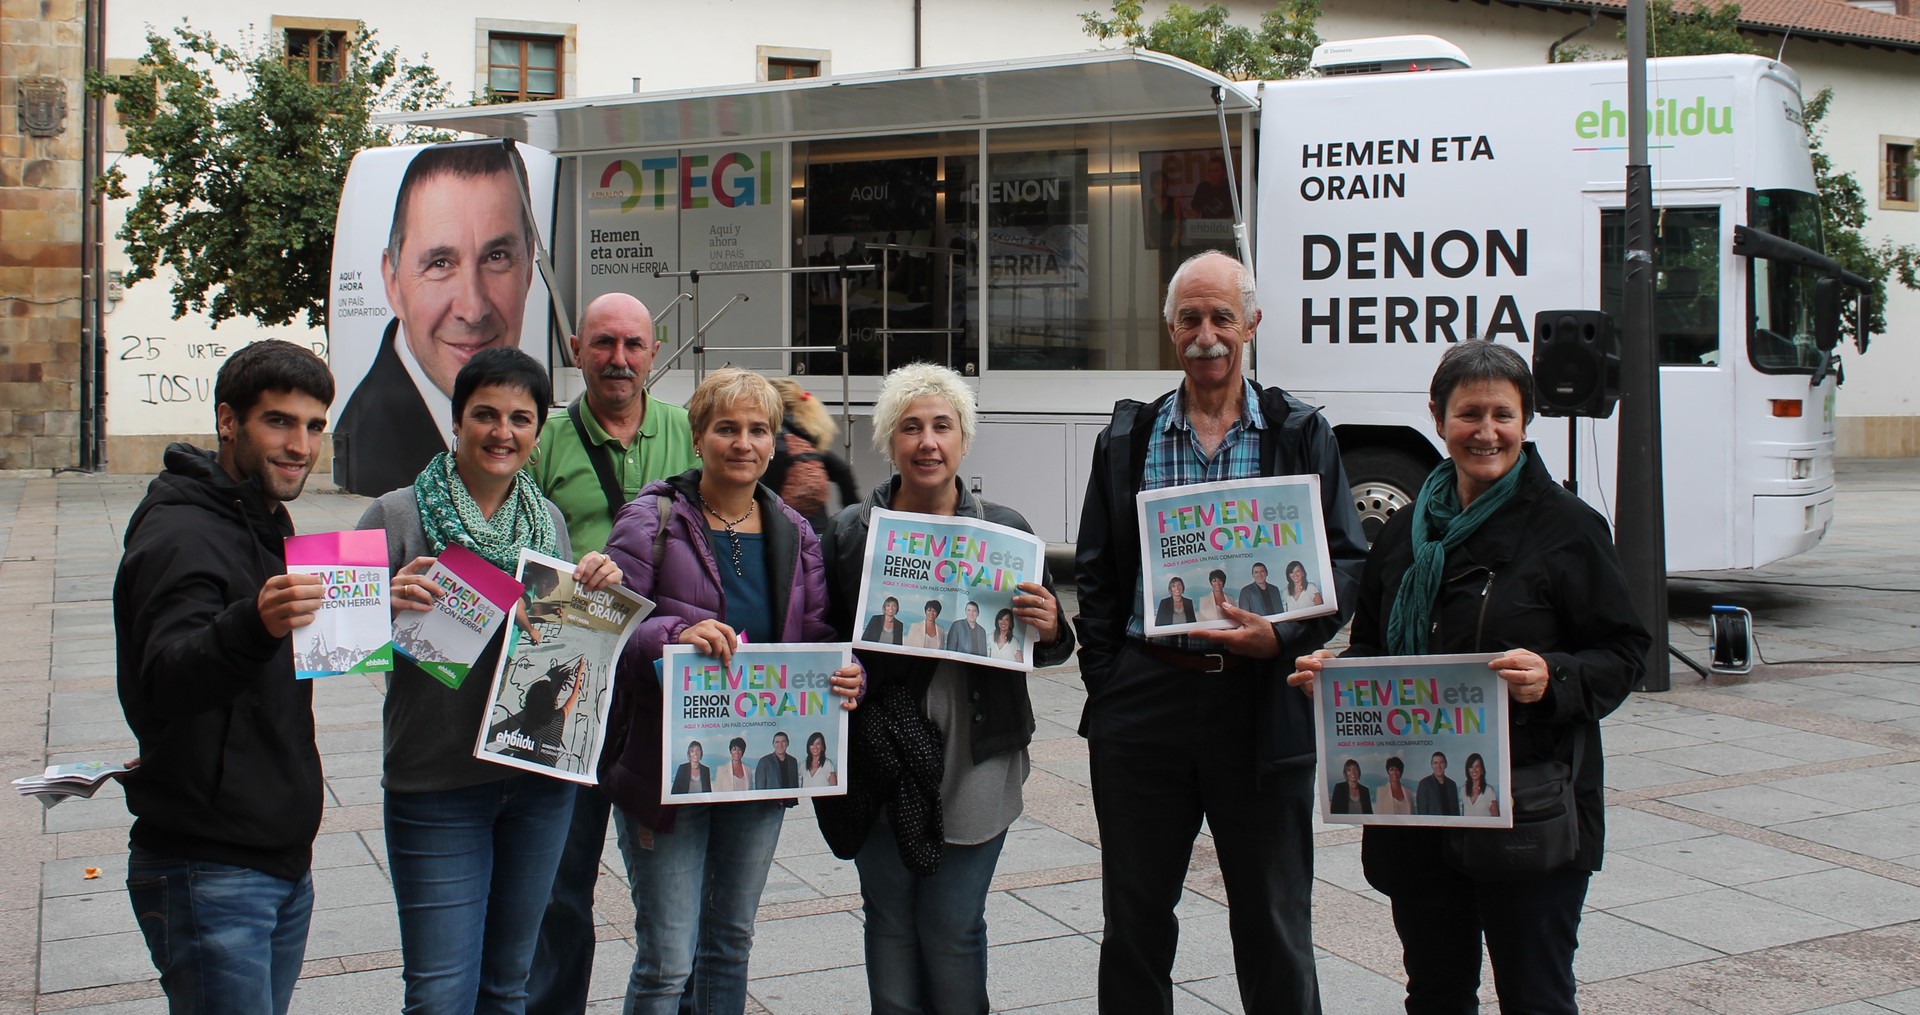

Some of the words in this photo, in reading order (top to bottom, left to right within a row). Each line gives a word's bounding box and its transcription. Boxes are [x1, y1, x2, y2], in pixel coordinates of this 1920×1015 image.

[1575, 96, 1733, 139] ehildu
[1302, 137, 1419, 168] HEMEN
[1431, 135, 1494, 163] ETA
[600, 151, 771, 214] OTEGI
[850, 182, 890, 201] AQUÍ
[1300, 173, 1406, 202] ORAIN
[590, 229, 640, 243] Hemen
[709, 223, 733, 237] Aquí
[735, 226, 741, 237] y
[1191, 223, 1229, 234] ehbildu
[590, 246, 612, 259] eta
[616, 243, 653, 258] orain
[709, 236, 737, 247] ahora
[710, 250, 723, 260] UN
[725, 248, 744, 259] PAÍS
[1302, 229, 1528, 281] DENON
[591, 263, 629, 275] DENON
[632, 261, 669, 273] HERRIA
[709, 260, 771, 271] COMPARTIDO
[357, 271, 362, 280] Y
[339, 282, 363, 291] AHORA
[338, 299, 347, 307] UN
[348, 296, 364, 306] PAÍS
[338, 307, 387, 317] COMPARTIDO
[1302, 295, 1530, 344] HERRIA
[120, 335, 166, 361] 25
[187, 342, 228, 359] URTE
[138, 373, 210, 405] IOSU
[1157, 498, 1260, 534] HEMEN
[1263, 502, 1299, 521] eta
[1160, 531, 1206, 548] DENON
[1209, 522, 1303, 551] ORAIN
[887, 530, 987, 563] HEMEN
[989, 550, 1024, 571] eta
[1161, 543, 1207, 559] HERRIA
[309, 570, 357, 585] MEN
[359, 571, 380, 582] eta
[883, 566, 930, 581] HERRIA
[884, 555, 931, 570] DENON
[934, 560, 1024, 594] ORAIN
[328, 583, 381, 599] ORAIN
[432, 571, 480, 607] HEMEN
[477, 603, 495, 618] eta
[347, 598, 381, 607] HERRIA
[448, 596, 491, 628] ORAIN
[612, 601, 631, 614] eta
[588, 602, 626, 625] ORAIN
[456, 614, 483, 635] HERRIA
[366, 658, 389, 667] ehbildu
[684, 664, 787, 691] HEMEN
[791, 669, 829, 689] eta
[1333, 678, 1439, 707] HEMEN
[1443, 682, 1484, 704] eta
[683, 694, 730, 706] DENON
[734, 691, 828, 717] ORAIN
[683, 706, 730, 719] HERRIA
[1336, 711, 1382, 723] DENON
[1386, 706, 1485, 736] ORAIN
[1336, 724, 1383, 736] HERRIA
[495, 729, 535, 751] ehbildu
